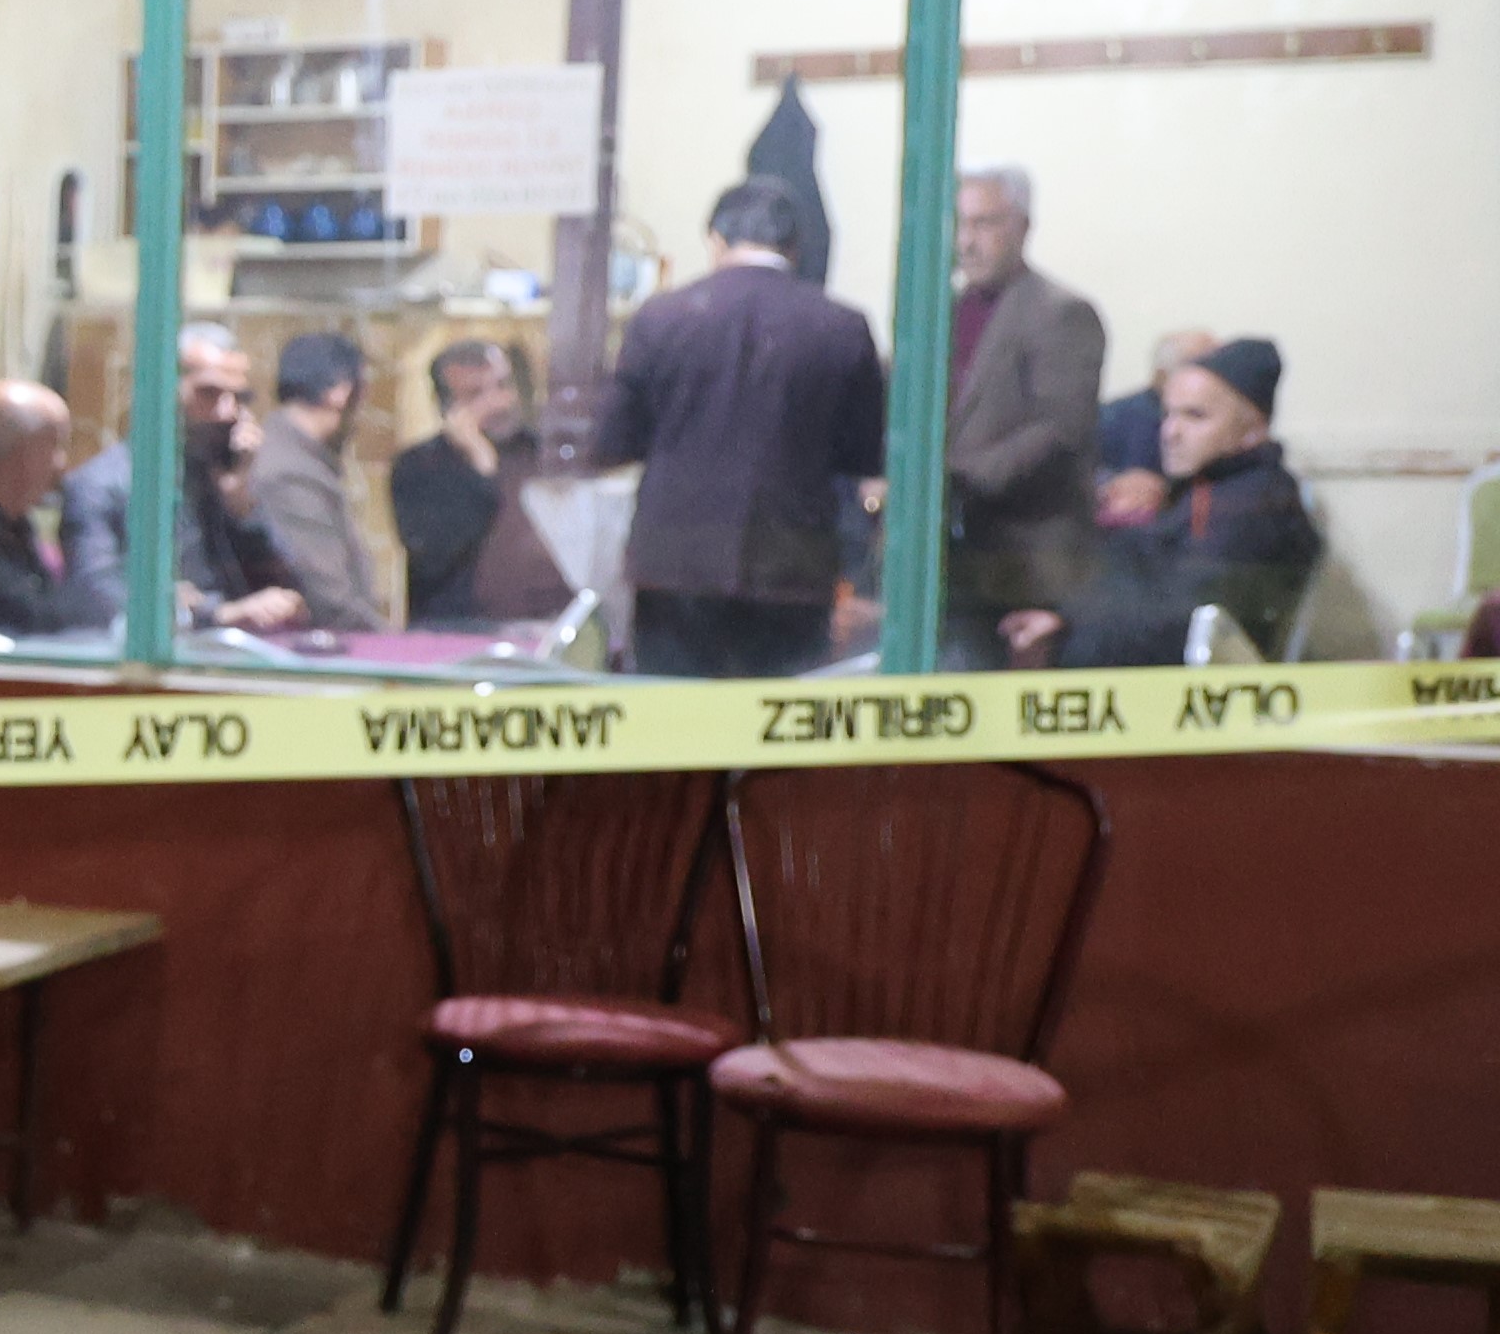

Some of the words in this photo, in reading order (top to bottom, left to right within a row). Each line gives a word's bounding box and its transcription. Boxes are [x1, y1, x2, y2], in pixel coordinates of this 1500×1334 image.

[362, 700, 630, 753] JANDARMA
[1174, 682, 1299, 730] OLAY
[122, 710, 252, 762] OLAY
